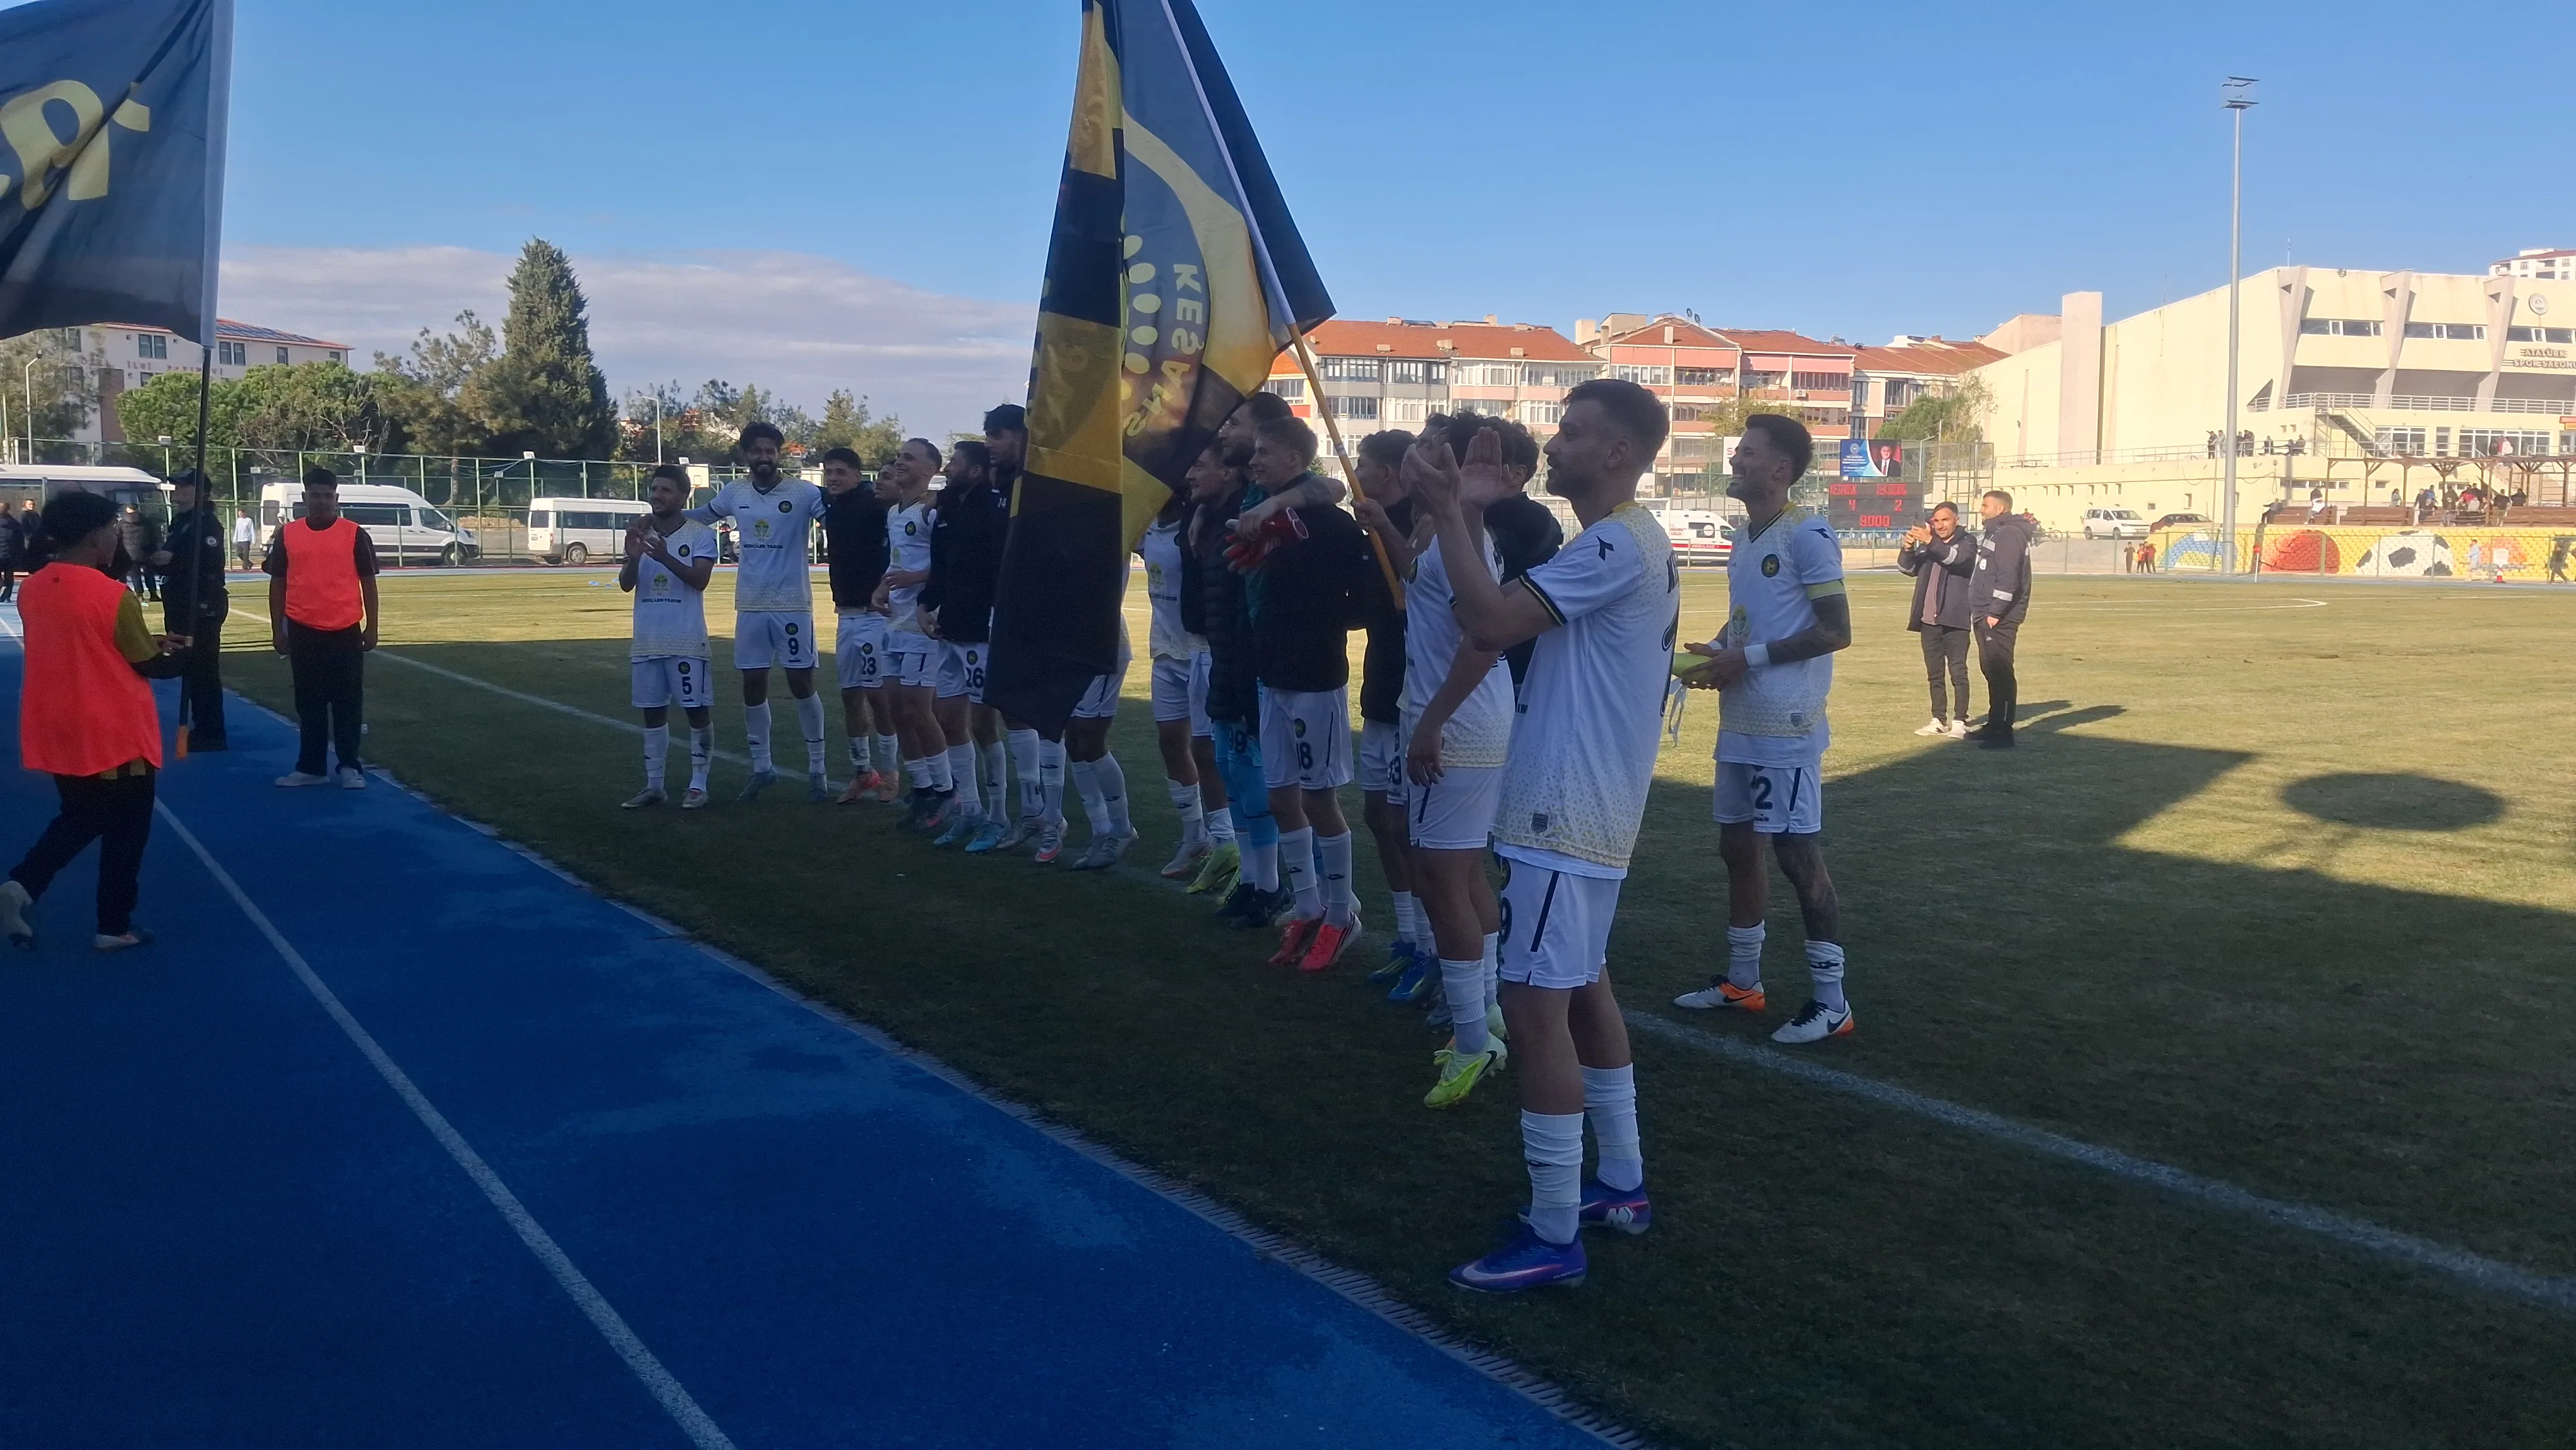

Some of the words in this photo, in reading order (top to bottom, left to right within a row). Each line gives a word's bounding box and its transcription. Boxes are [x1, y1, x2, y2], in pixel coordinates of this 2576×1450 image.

[2525, 348, 2565, 358] ATATÜRK
[2513, 359, 2539, 368] SPOR
[997, 497, 1007, 508] 14
[1848, 500, 1857, 512] 4
[1894, 500, 1903, 512] 2
[1859, 515, 1891, 527] 9000
[788, 637, 799, 656] 9
[681, 676, 693, 695] 5
